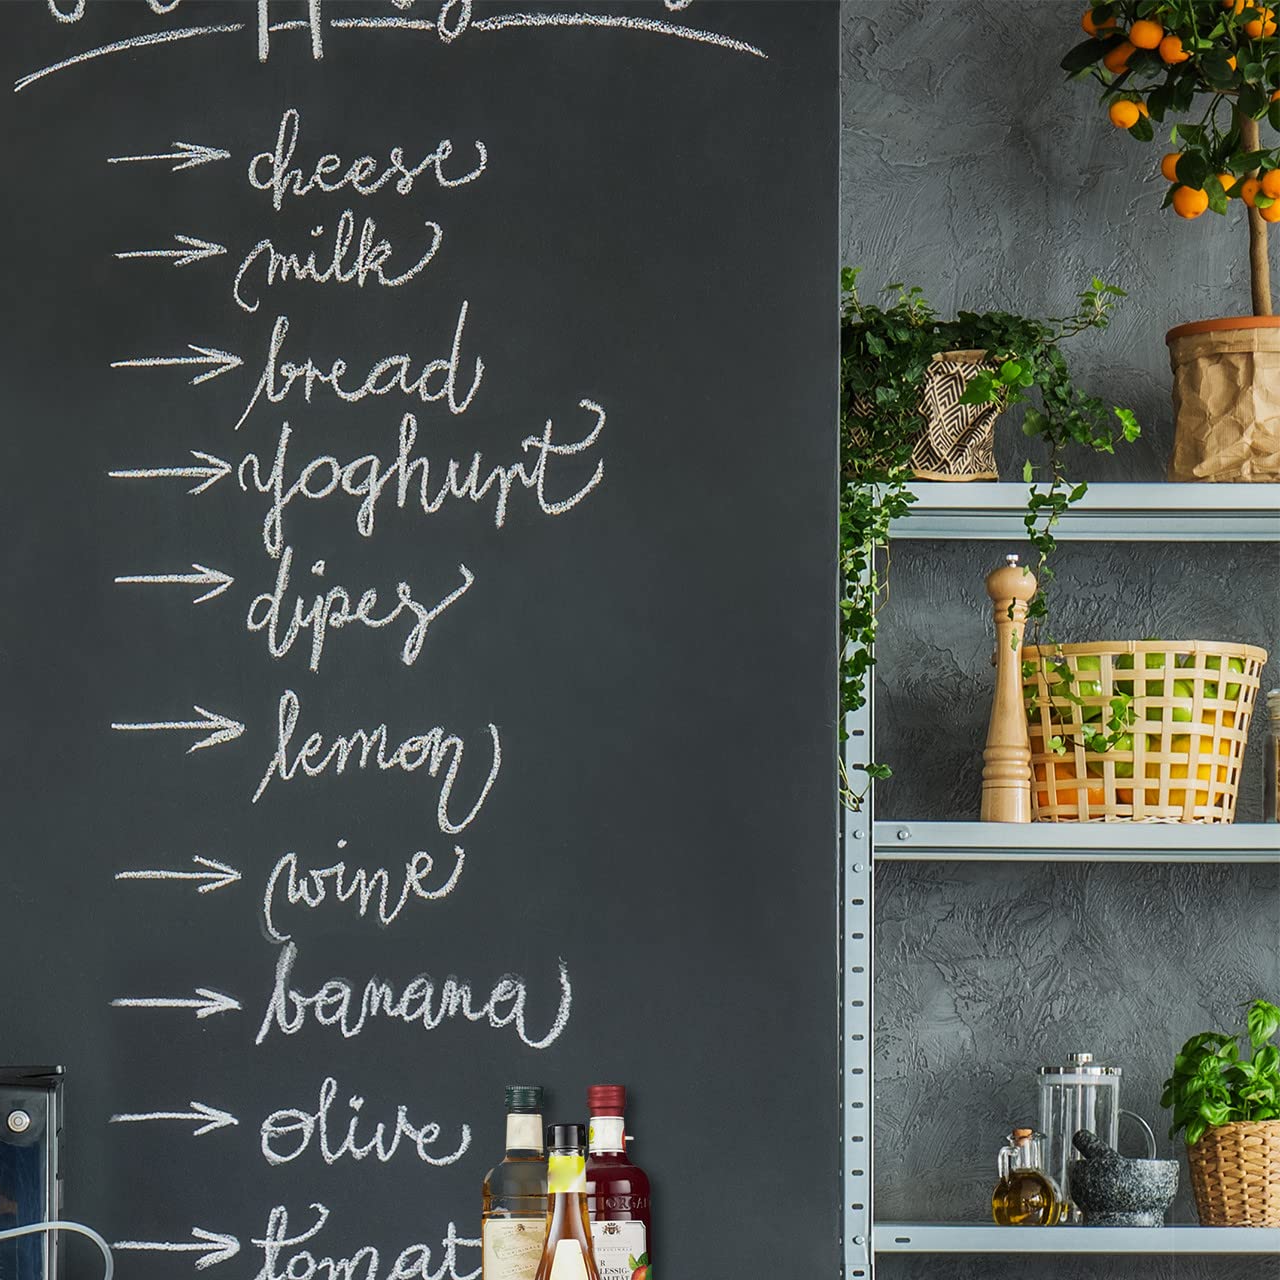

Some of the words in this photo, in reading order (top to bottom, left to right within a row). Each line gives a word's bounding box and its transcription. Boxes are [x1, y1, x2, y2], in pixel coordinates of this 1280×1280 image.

[248, 109, 487, 211] cheese
[234, 209, 443, 312] milk
[235, 301, 485, 430] bread
[238, 399, 606, 557] yoghurt
[252, 690, 501, 834] lemon
[264, 839, 465, 941] wine
[256, 942, 572, 1049] banana
[261, 1077, 471, 1166] olive
